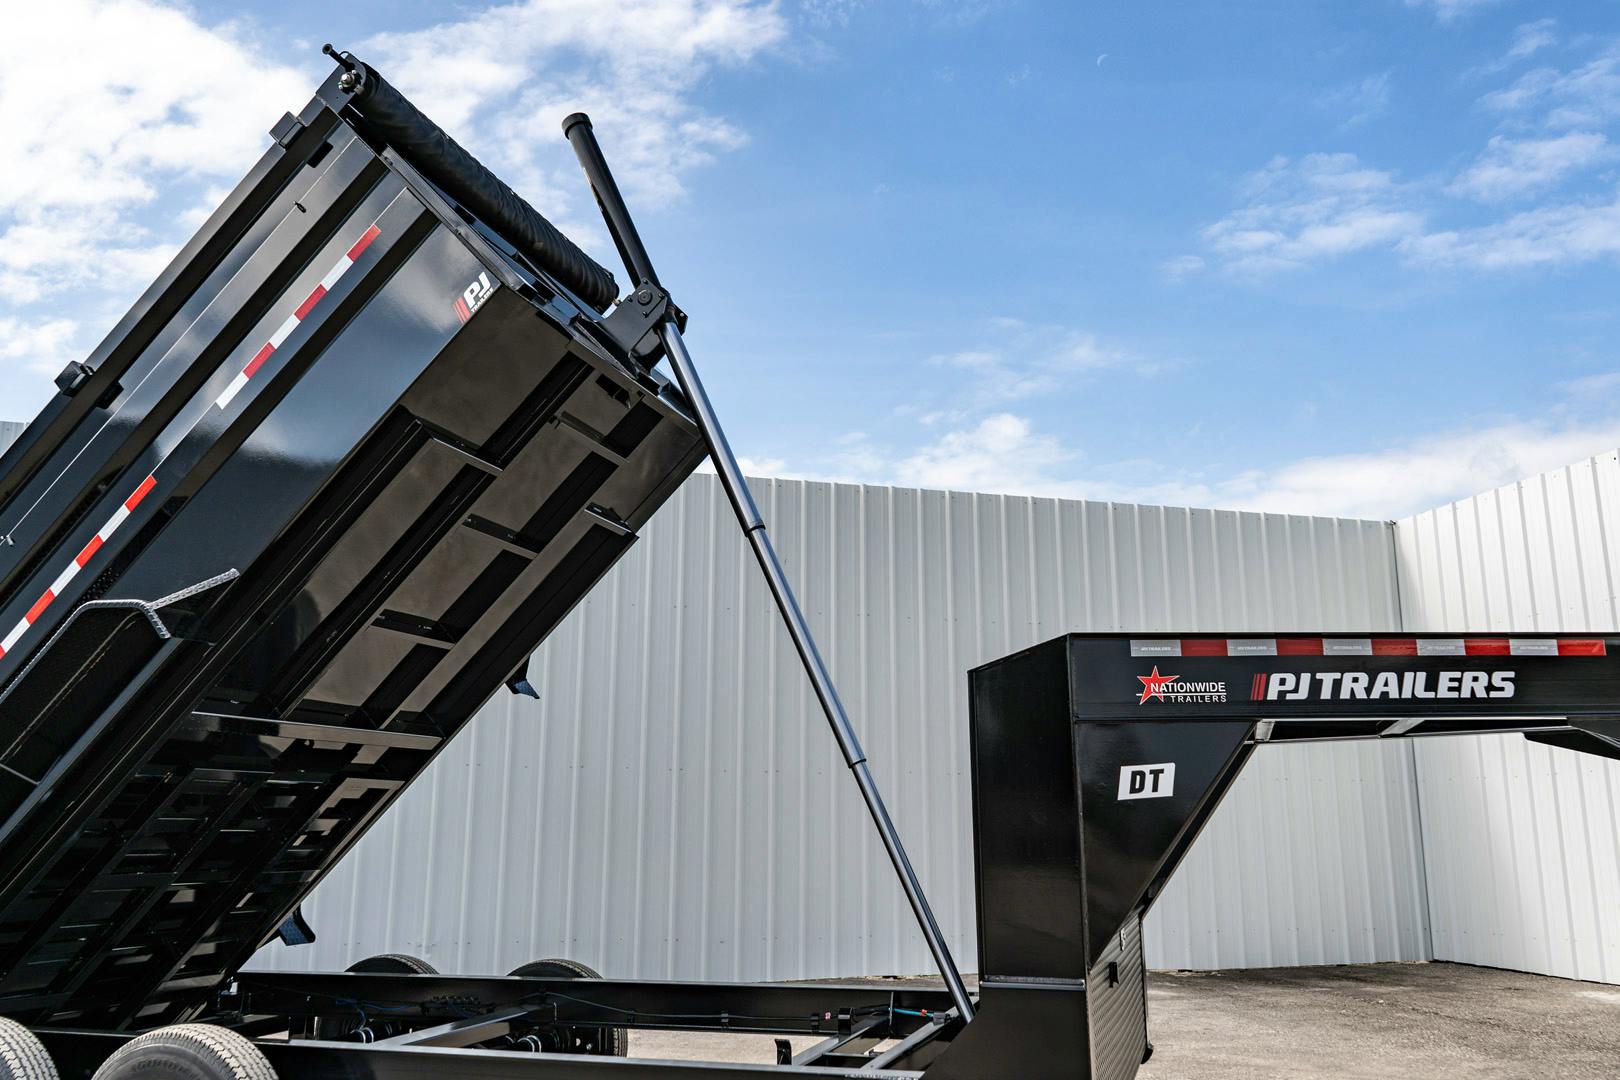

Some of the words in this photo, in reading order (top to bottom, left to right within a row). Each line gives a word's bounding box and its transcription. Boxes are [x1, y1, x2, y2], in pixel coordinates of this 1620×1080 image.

[463, 271, 491, 309] PJ
[1150, 682, 1226, 693] NATIONWIDE
[1170, 695, 1227, 703] TRAILERS
[1266, 672, 1311, 701] PJ
[1315, 671, 1516, 700] TRAILERS
[1129, 768, 1165, 795] DT
